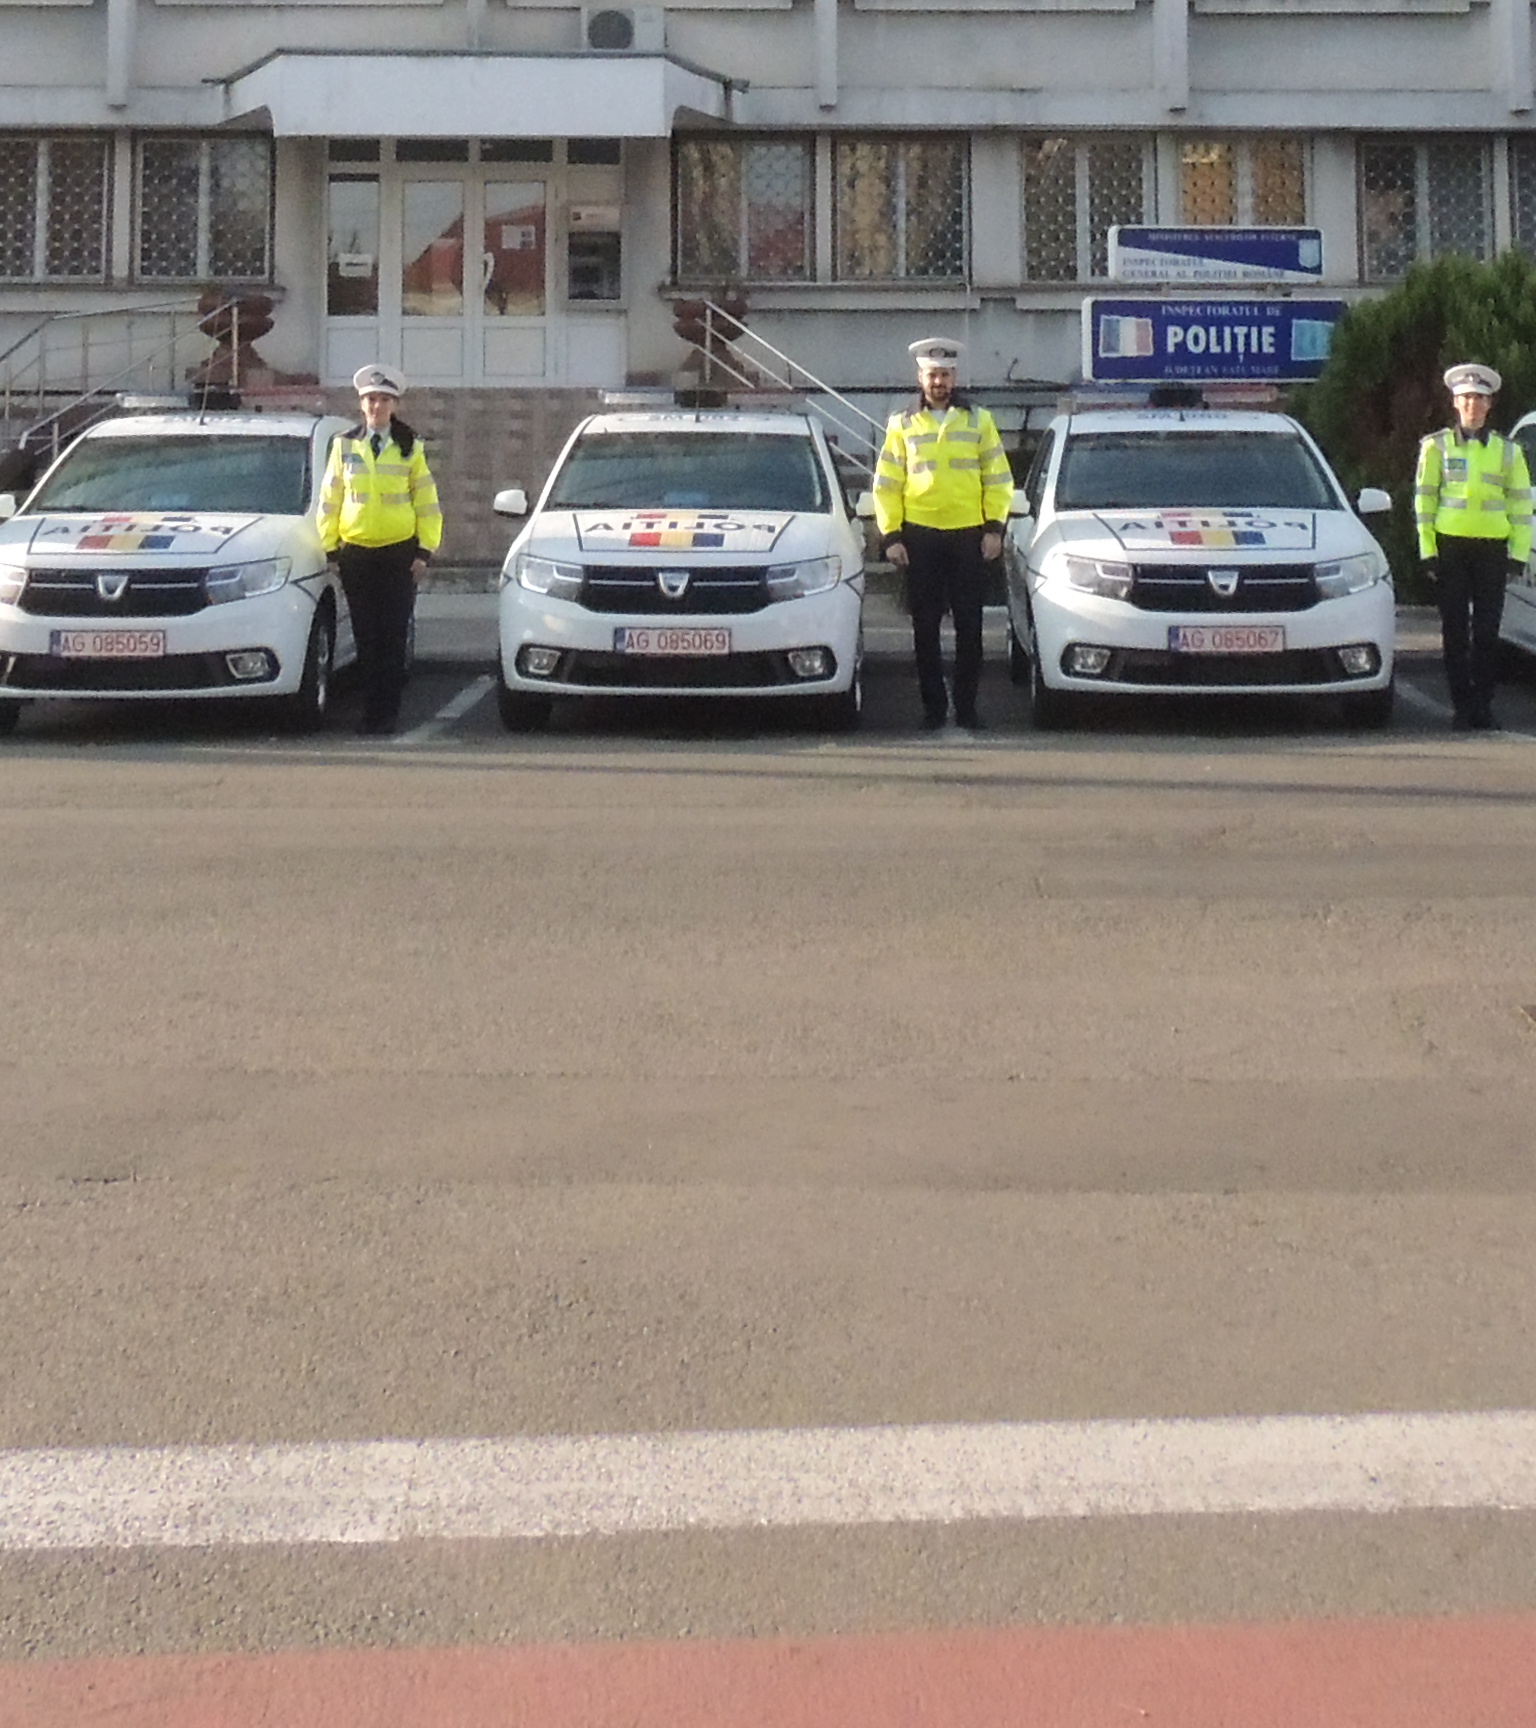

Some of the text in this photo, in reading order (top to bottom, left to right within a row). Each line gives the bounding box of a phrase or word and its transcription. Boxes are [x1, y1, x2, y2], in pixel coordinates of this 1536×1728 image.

[1162, 305, 1260, 317] INSPECTORATUL
[1167, 325, 1276, 364] POLIȚIE
[60, 633, 162, 653] AG 085059
[625, 631, 728, 651] AG 085069
[1180, 630, 1280, 649] AG 085067
